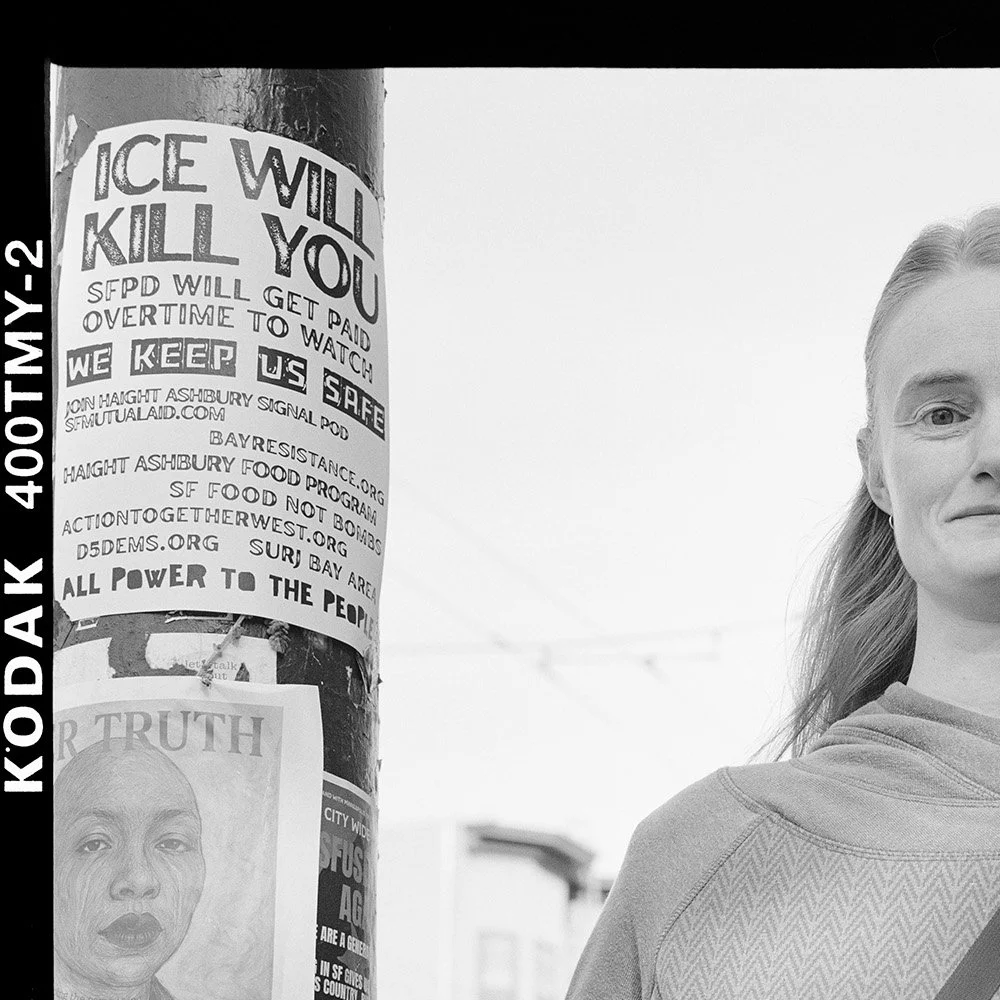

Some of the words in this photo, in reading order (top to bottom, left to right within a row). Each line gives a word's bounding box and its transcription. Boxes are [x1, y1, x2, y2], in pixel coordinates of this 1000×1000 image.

[95, 134, 207, 201] ICE
[230, 138, 375, 261] WILL
[81, 203, 239, 271] KILL
[261, 212, 378, 324] YOU
[83, 303, 234, 333] OVERTIME
[247, 309, 289, 338] TO
[300, 324, 373, 384] WATCH
[87, 275, 160, 303] SFPD
[173, 274, 250, 301] WILL
[263, 286, 320, 320] GET
[329, 308, 371, 352] PAID
[4, 240, 43, 509] 400TMY-2
[68, 346, 110, 382] WE
[134, 341, 236, 373] KEEP
[261, 350, 306, 390] US
[325, 373, 385, 434] SAFE
[65, 396, 95, 418] JOIN
[99, 388, 161, 409] HAIGHT
[166, 388, 253, 407] ASHBURY
[257, 396, 317, 426] SIGNAL
[321, 416, 349, 440] POD
[65, 405, 225, 432] SFMUTUALAID.COM
[64, 457, 129, 484] HAIGHT
[134, 454, 235, 473] ASHBURY
[242, 459, 301, 486] FOOD
[306, 475, 377, 526] PROGRAM
[210, 430, 385, 506] BAYRESISTANCE.ORG
[62, 507, 348, 558] ACTIONTOGETHERWEST.ORG
[169, 481, 198, 498] SF
[208, 482, 277, 507] FOOD
[286, 495, 327, 523] NOT
[333, 513, 382, 556] BOMBS
[62, 573, 100, 600] ALL
[112, 564, 207, 591] POWER
[221, 567, 256, 592] TO
[269, 574, 313, 606] THE
[77, 534, 219, 560] D5DEMS.ORG
[249, 538, 301, 569] SURJ
[309, 554, 342, 580] BAY
[348, 572, 377, 604] AREA
[3, 558, 43, 793] KODAK
[214, 660, 237, 671] talk
[57, 719, 78, 761] R
[95, 710, 264, 757] TRUTH
[324, 807, 349, 828] CITY
[320, 926, 339, 945] ARE
[340, 932, 346, 948] A
[320, 960, 330, 977] IN
[332, 964, 343, 981] SF
